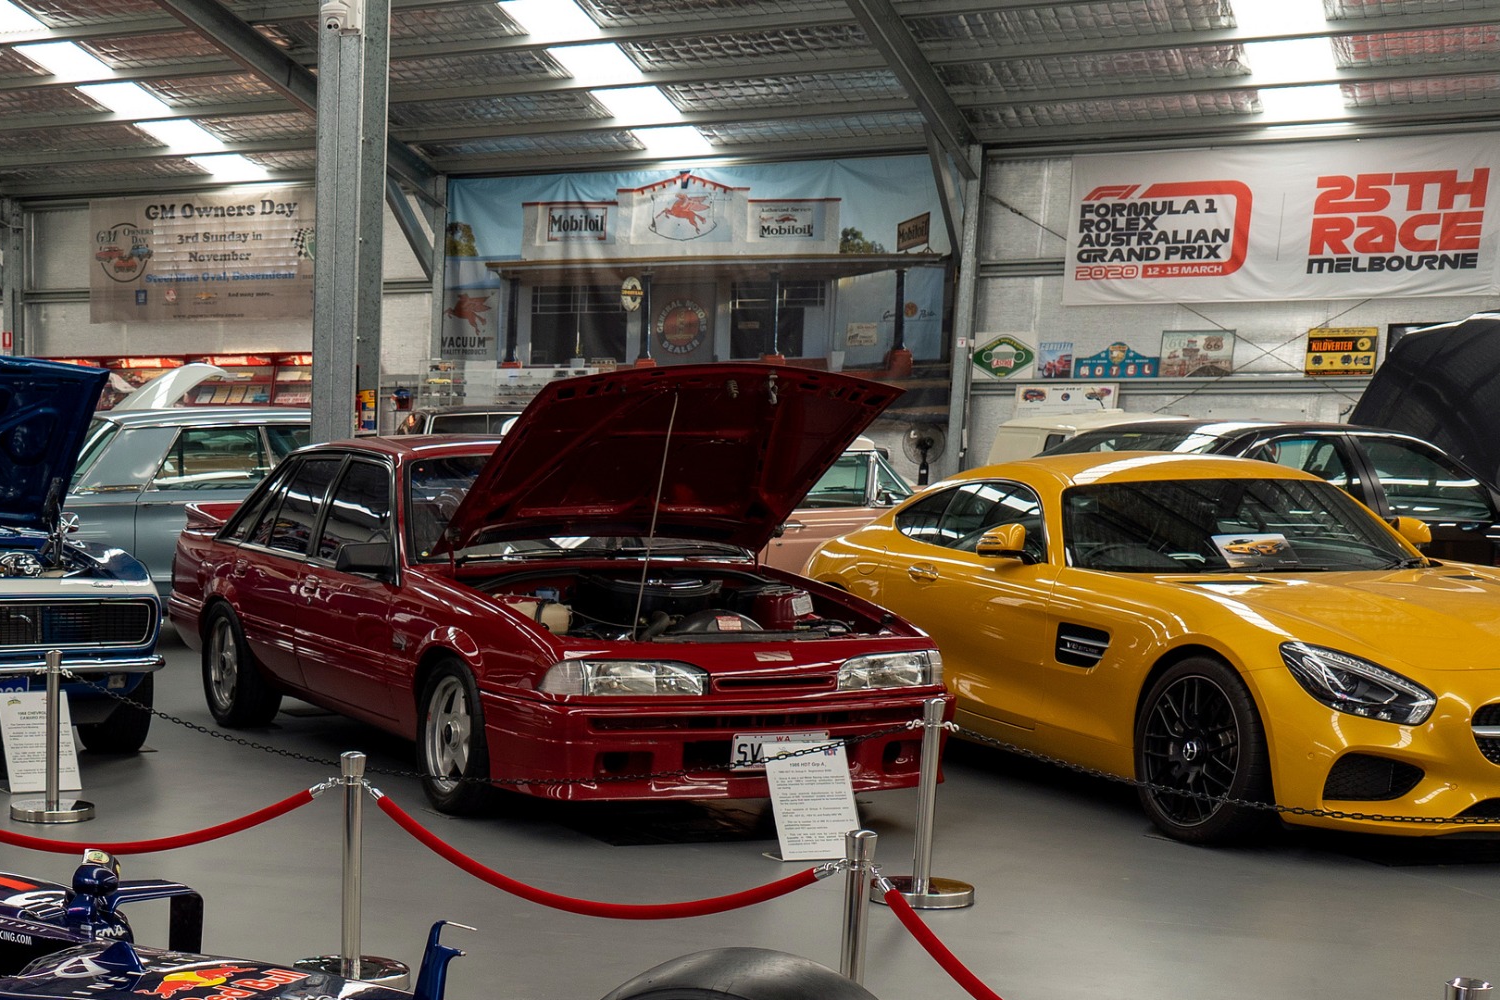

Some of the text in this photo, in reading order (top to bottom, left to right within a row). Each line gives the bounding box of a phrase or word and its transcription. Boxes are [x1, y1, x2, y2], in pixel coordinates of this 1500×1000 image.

[1314, 167, 1490, 215] 25TH
[145, 199, 298, 220] GM Owners Day
[1081, 198, 1218, 218] FORMULA 1
[550, 208, 606, 233] Mobiloil
[1079, 216, 1158, 232] ROLEX
[96, 230, 118, 244] GM
[177, 231, 263, 245] 3rd Sunday in
[760, 225, 813, 238] Mobiloil
[898, 219, 930, 245] Mobiloil
[1077, 228, 1230, 249] AUSTRALIAN
[188, 251, 252, 263] November
[1076, 244, 1222, 264] GRAND PRIX
[1180, 265, 1222, 274] MARCH
[1306, 252, 1479, 274] MELBOURNE
[201, 272, 229, 284] Oval,
[231, 271, 295, 281] Bassendean
[1075, 265, 1139, 280] 2020
[656, 300, 707, 334] GENERAL MOTORS
[441, 336, 486, 349] VACUUM
[661, 338, 700, 354] DEALER
[1206, 337, 1221, 350] 66
[1079, 364, 1151, 377] MOTEL
[229, 967, 312, 992] Bull
